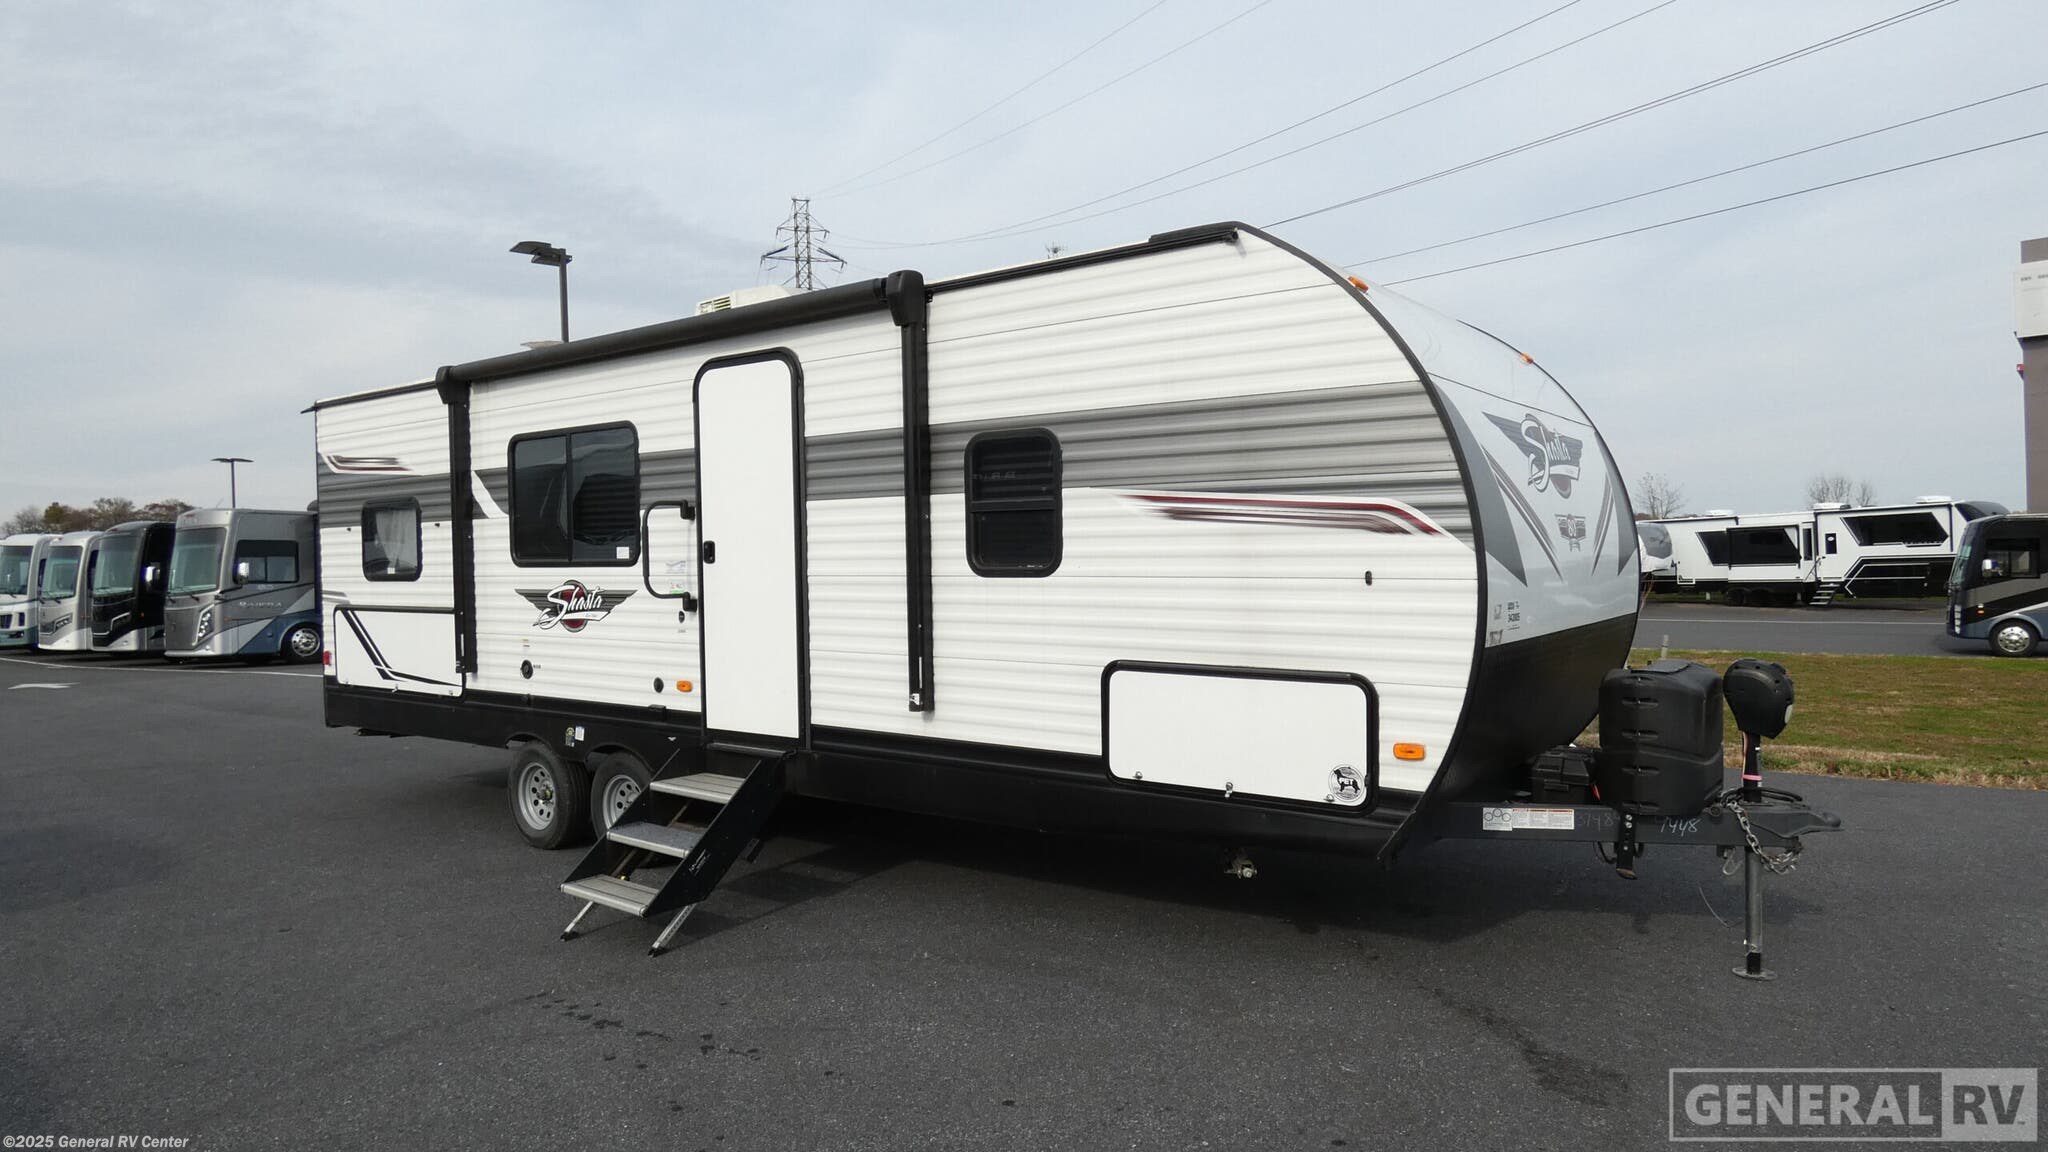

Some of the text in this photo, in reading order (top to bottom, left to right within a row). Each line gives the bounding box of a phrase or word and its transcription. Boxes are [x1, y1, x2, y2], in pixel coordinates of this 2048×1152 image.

[1521, 419, 1571, 493] Shasta
[535, 584, 605, 630] Shasta
[1339, 778, 1354, 786] PET
